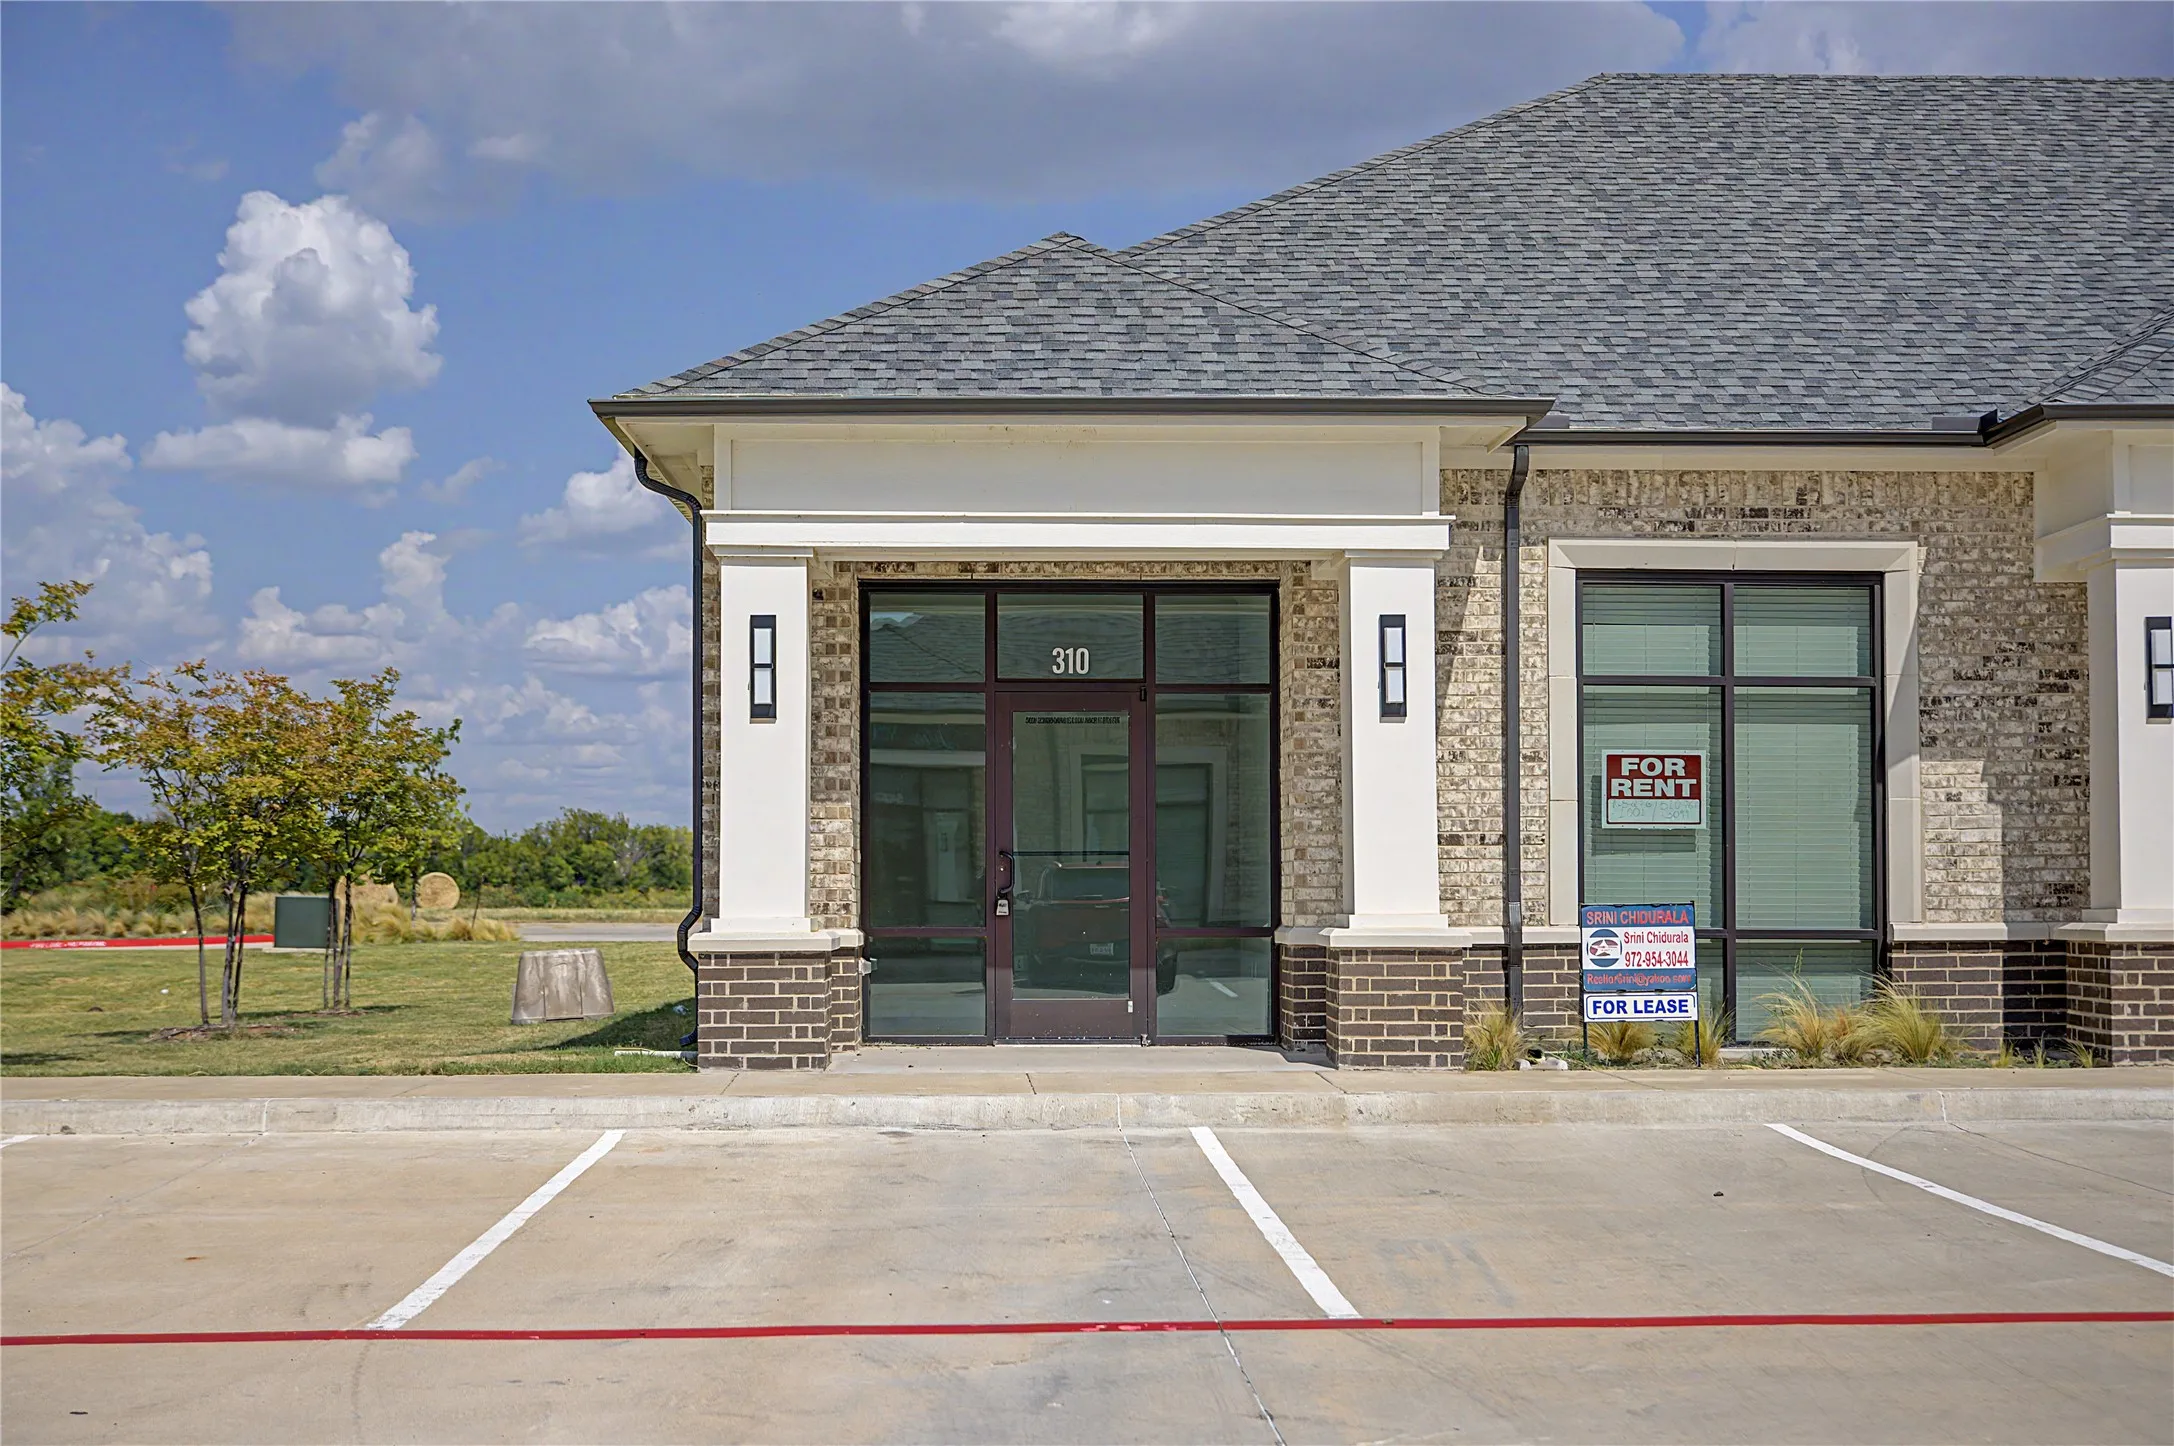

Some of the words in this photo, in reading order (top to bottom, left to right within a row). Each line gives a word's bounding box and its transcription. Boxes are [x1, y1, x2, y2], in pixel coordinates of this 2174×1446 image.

[1052, 647, 1089, 674] 310
[1621, 757, 1686, 777] FOR
[1611, 778, 1697, 797] RENT
[1586, 911, 1618, 925] SRINI
[1620, 910, 1689, 924] CHIDURALA
[1624, 931, 1644, 943] Srini
[1647, 931, 1689, 943] Chidurala
[1625, 951, 1689, 967] 972-954-3044
[1592, 1000, 1628, 1014] FOR
[1633, 999, 1689, 1014] LEASE
